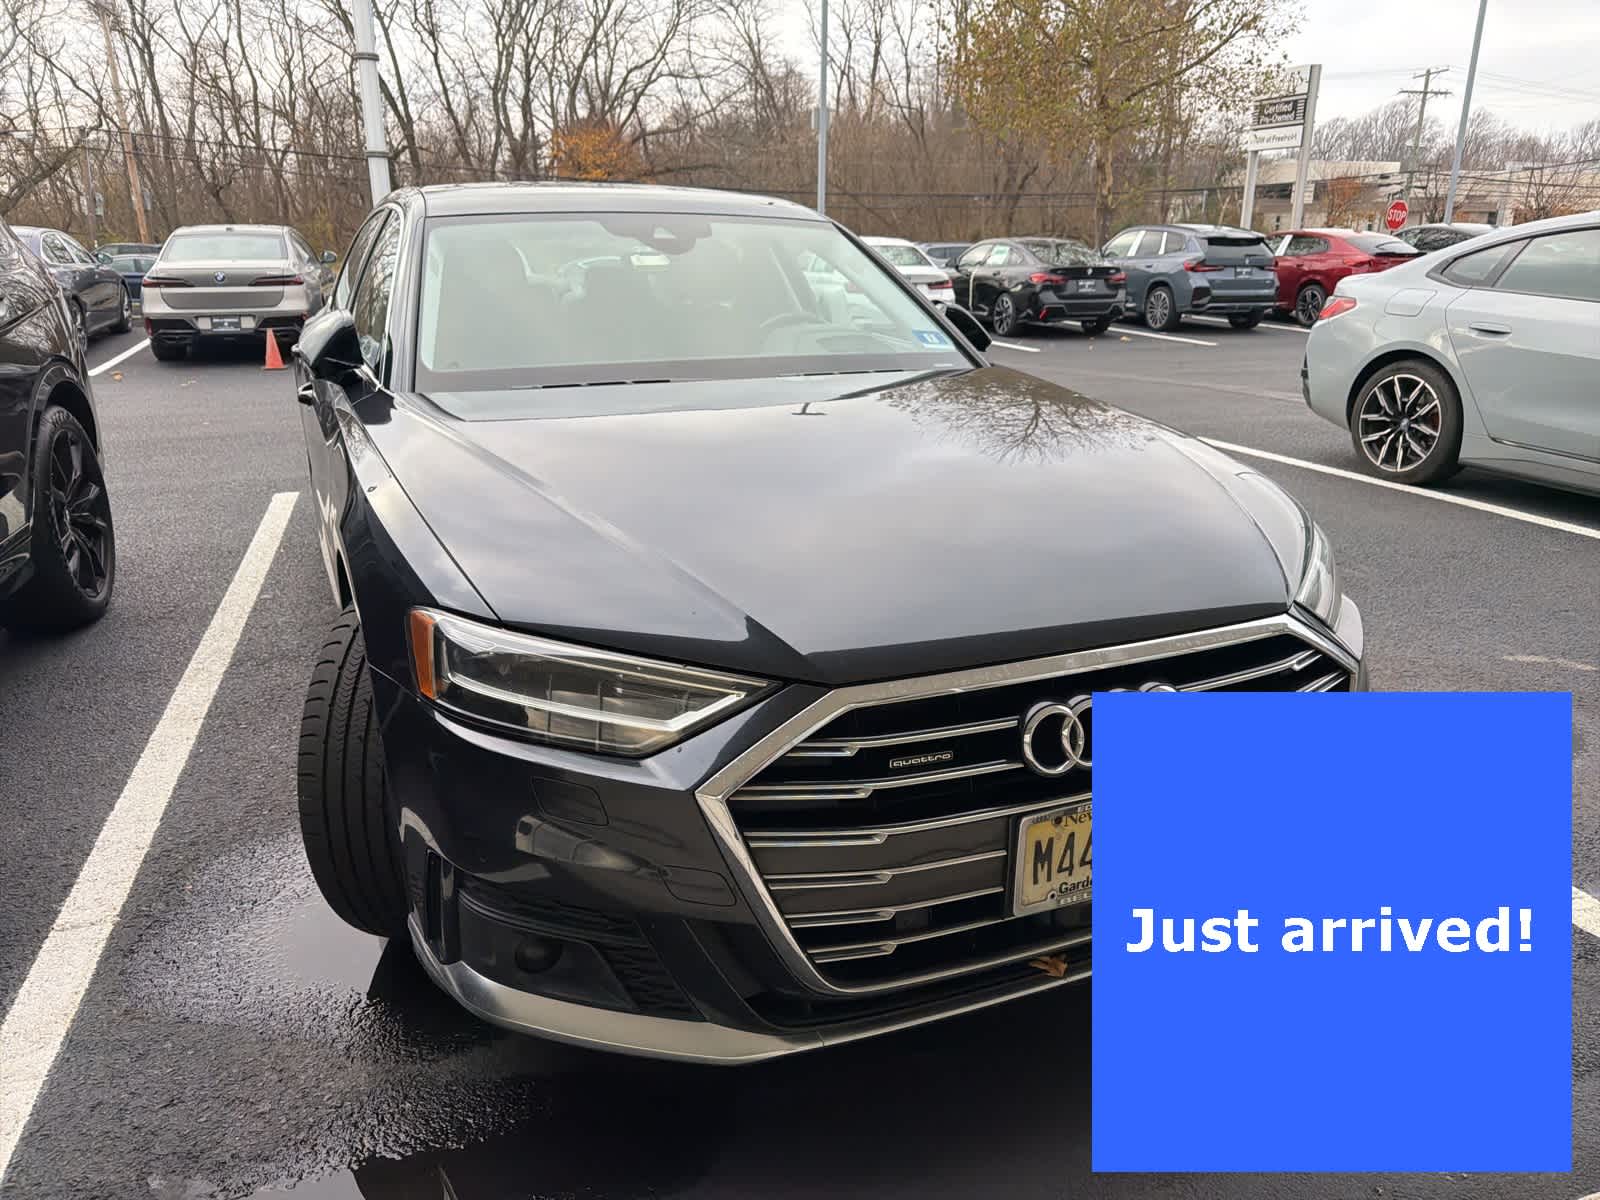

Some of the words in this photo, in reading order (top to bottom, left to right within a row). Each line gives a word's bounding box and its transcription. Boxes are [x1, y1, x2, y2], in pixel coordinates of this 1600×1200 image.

[1264, 101, 1293, 114] Certified
[1388, 209, 1407, 222] STOP
[893, 753, 951, 767] quattro
[1058, 877, 1092, 894] Gard
